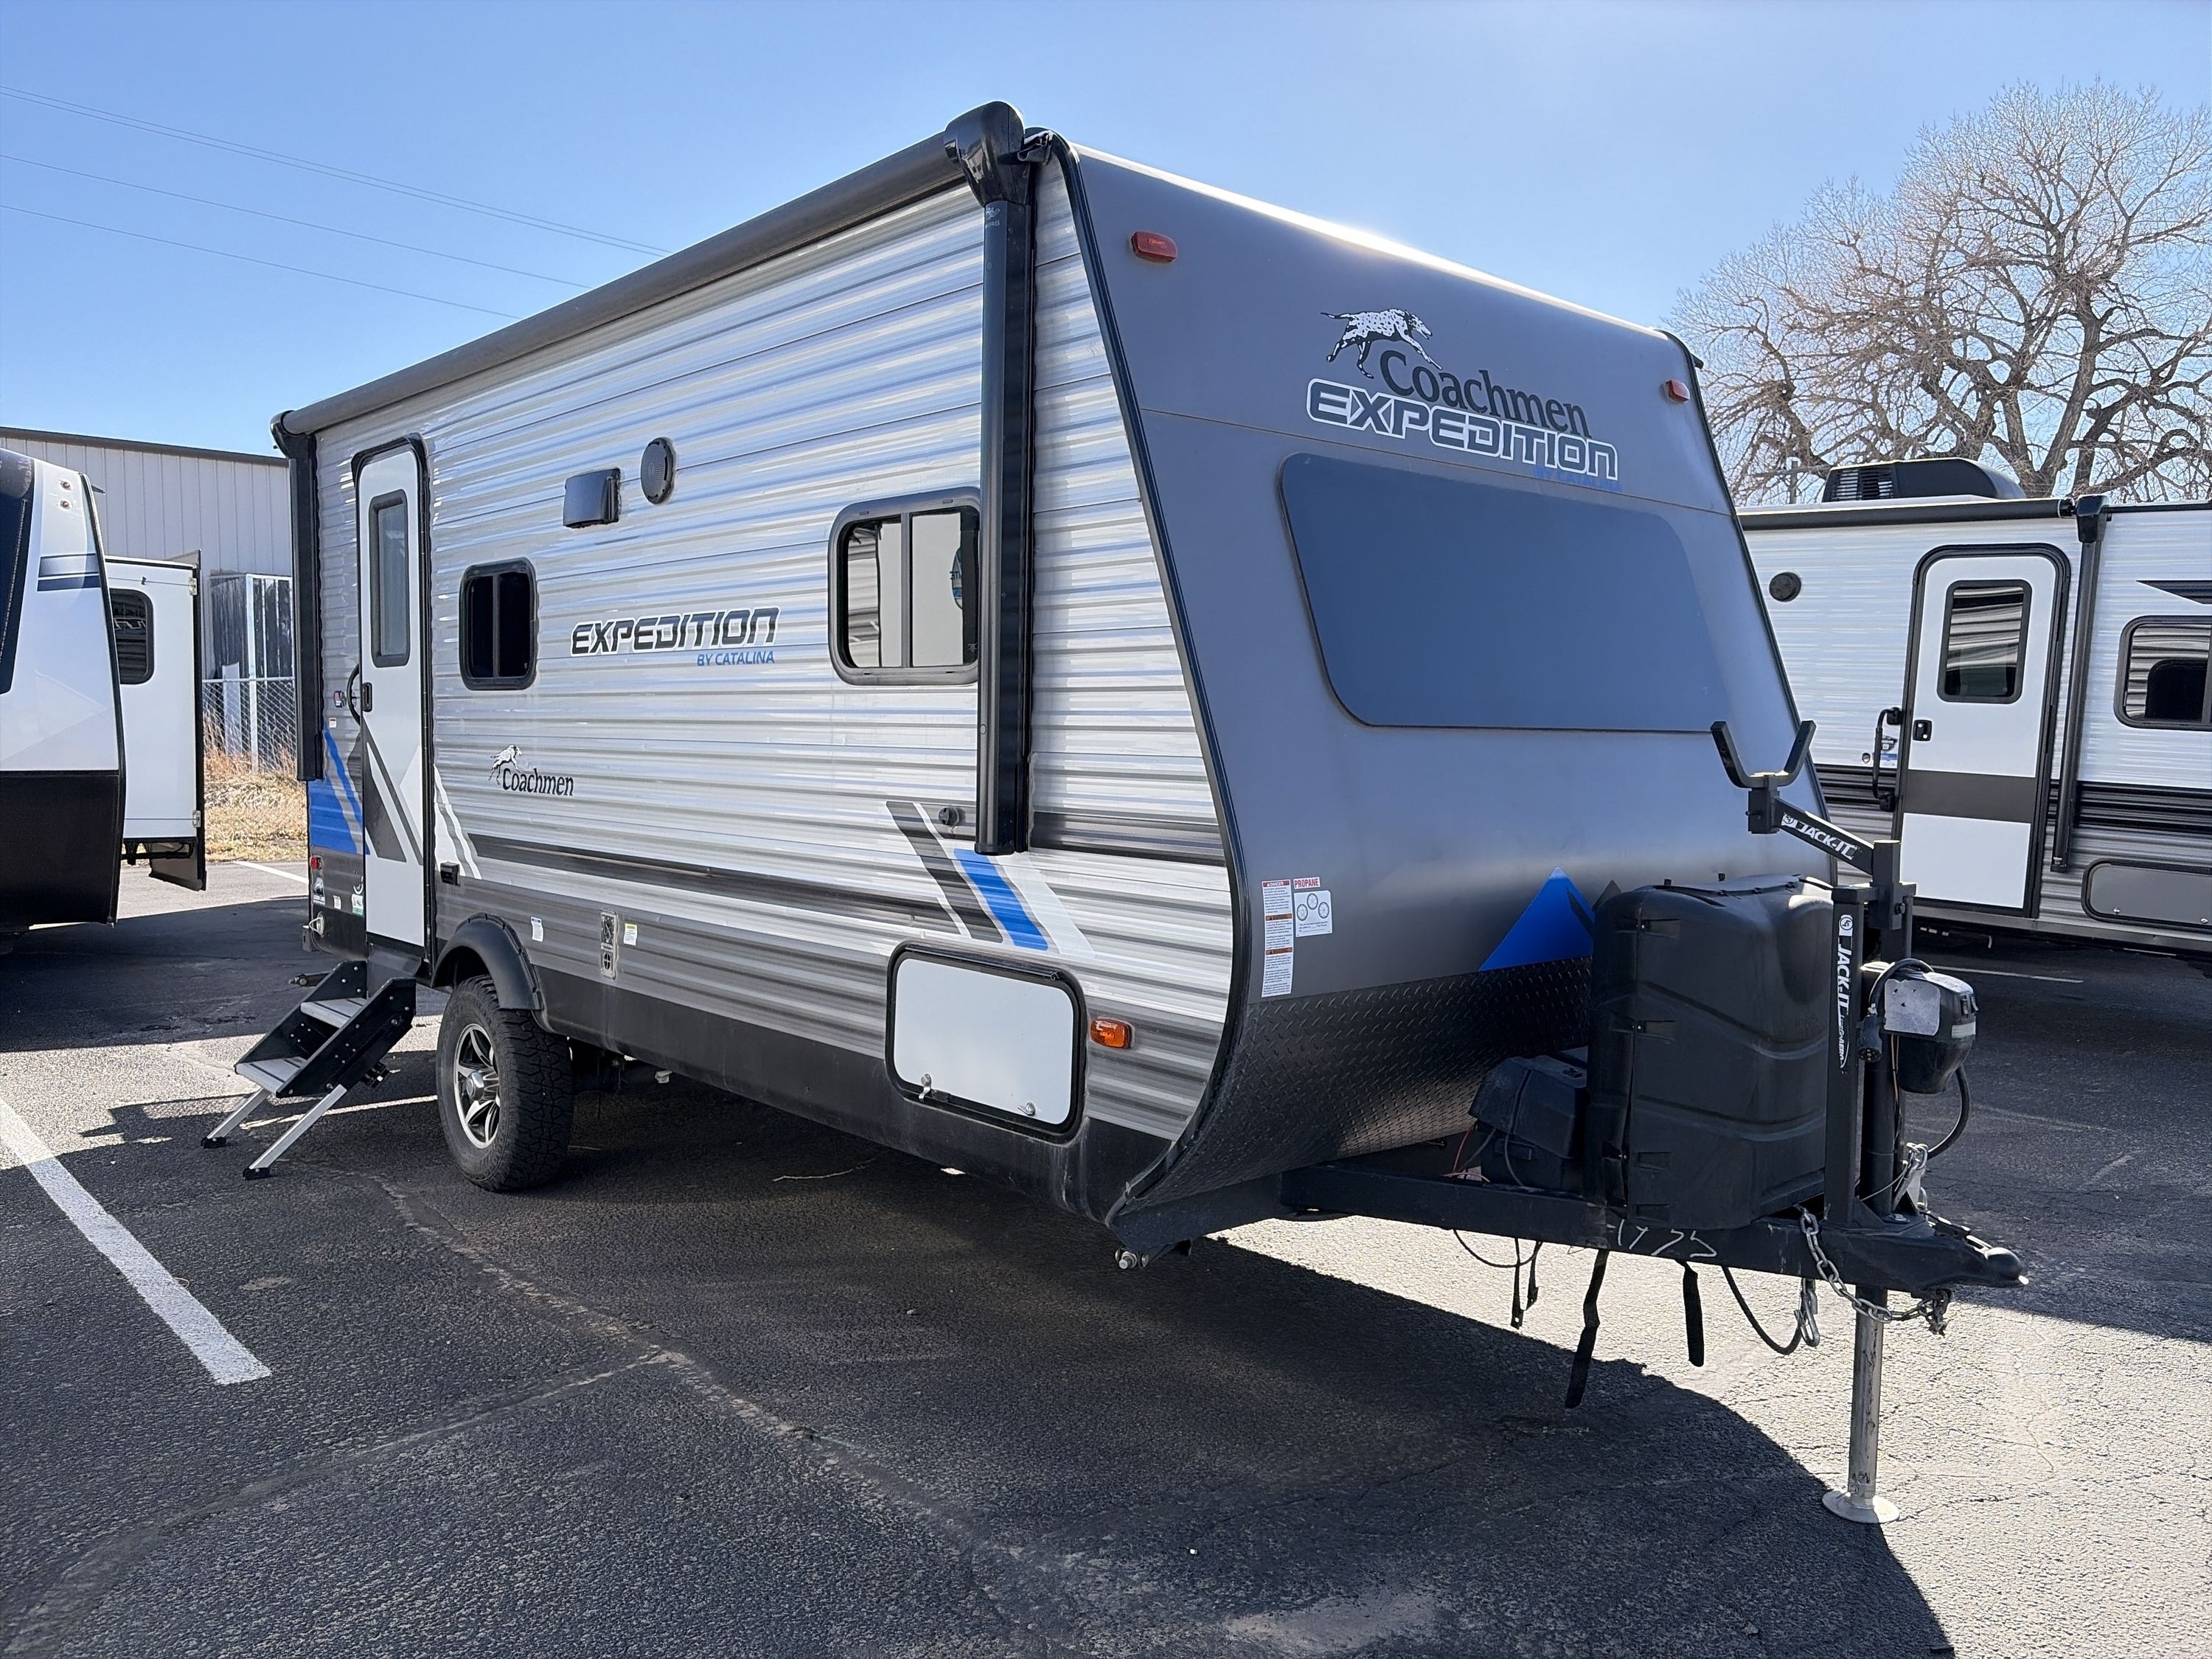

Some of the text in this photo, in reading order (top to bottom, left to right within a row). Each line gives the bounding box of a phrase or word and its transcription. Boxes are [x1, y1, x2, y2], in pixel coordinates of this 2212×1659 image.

[1380, 349, 1592, 439] Coachmen
[1307, 378, 1619, 481] EXPEDITION
[571, 606, 781, 656] EXPEDITION
[697, 650, 775, 667] BY CATALINA
[502, 768, 574, 796] Coachmen
[1798, 822, 1857, 859] JACK-IT
[1295, 878, 1318, 888] PROPANE
[1837, 944, 1852, 1013] JACK-IT
